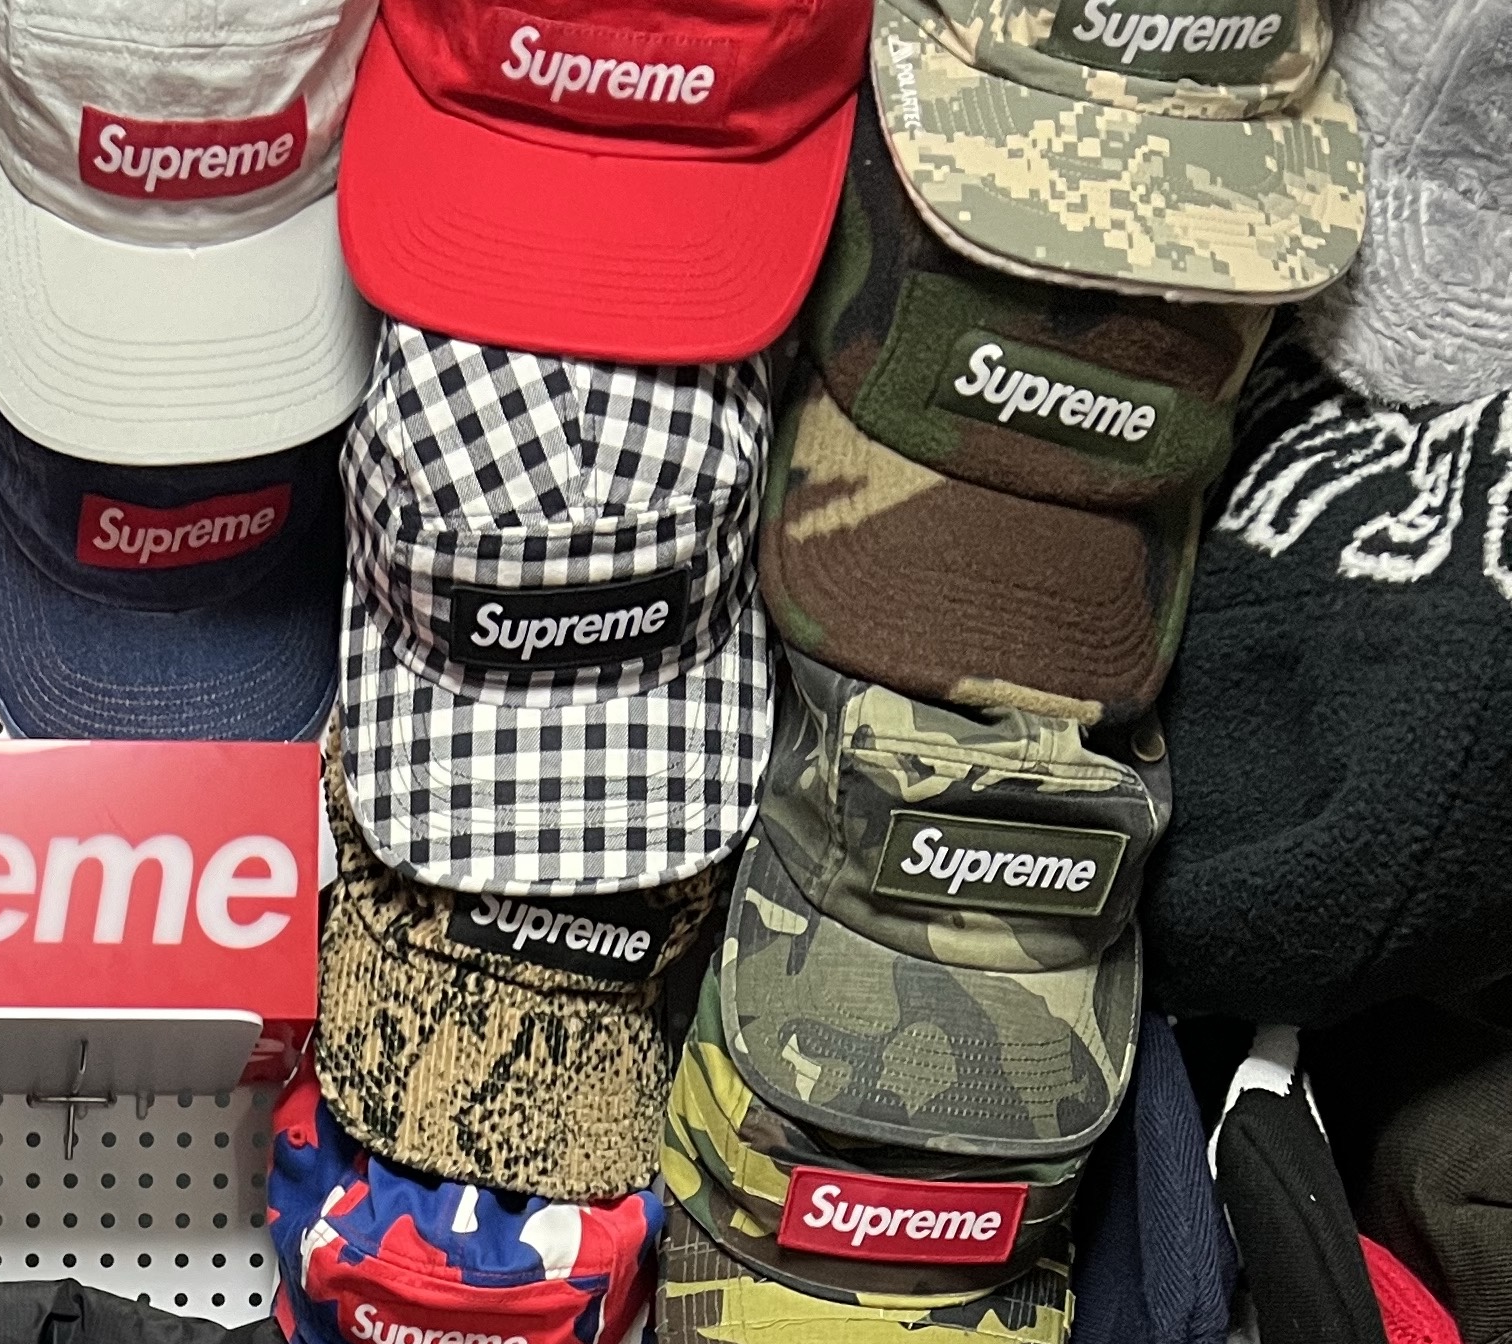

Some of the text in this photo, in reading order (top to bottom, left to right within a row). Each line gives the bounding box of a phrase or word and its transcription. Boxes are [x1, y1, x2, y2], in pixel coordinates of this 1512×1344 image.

[501, 25, 715, 105] Supreme
[1072, 0, 1282, 64] Supreme
[92, 122, 294, 192] Supreme
[954, 342, 1156, 441] Supreme
[92, 507, 275, 564] Supreme
[470, 600, 669, 661] Supreme
[900, 827, 1096, 895] Supreme
[802, 1184, 1002, 1247] Supreme
